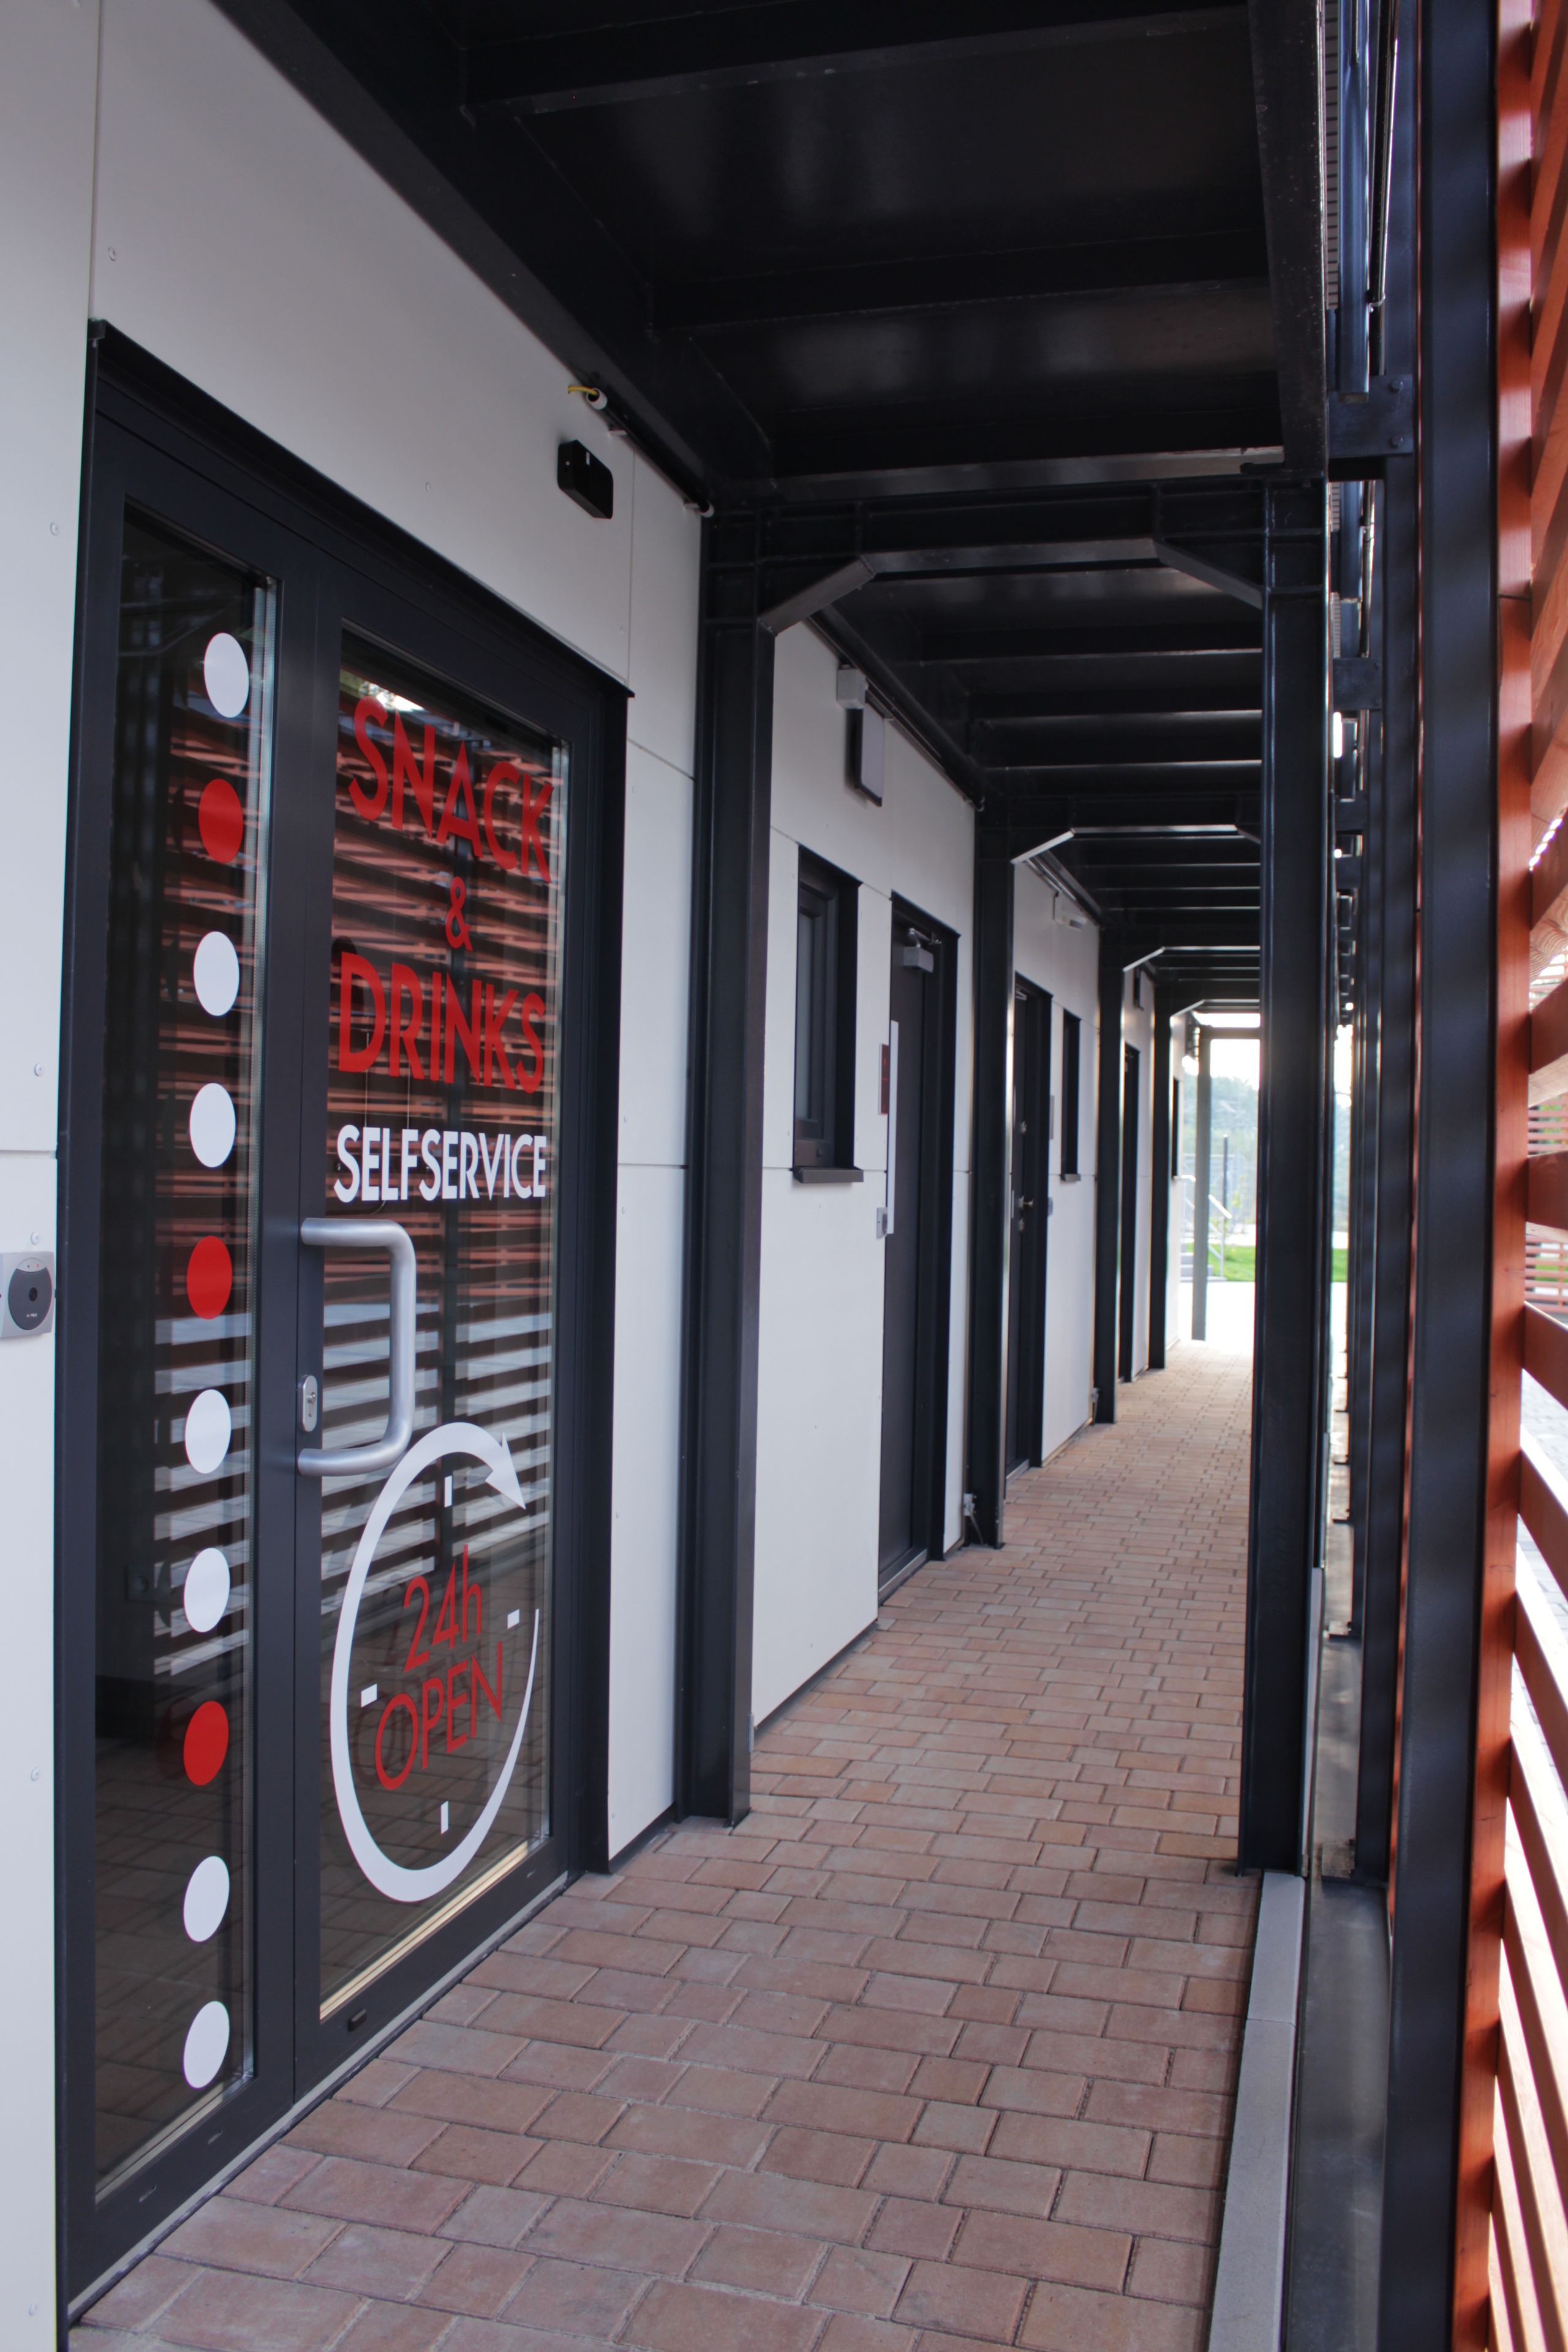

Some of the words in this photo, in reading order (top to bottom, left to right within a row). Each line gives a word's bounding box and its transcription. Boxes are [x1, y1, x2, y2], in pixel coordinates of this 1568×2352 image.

[349, 696, 554, 882] SNACK
[445, 876, 473, 951] &
[338, 952, 546, 1094] DRINKS
[334, 1125, 547, 1203] SELFSERVICE
[403, 1544, 482, 1673] 24h
[375, 1640, 502, 1790] OPEN
